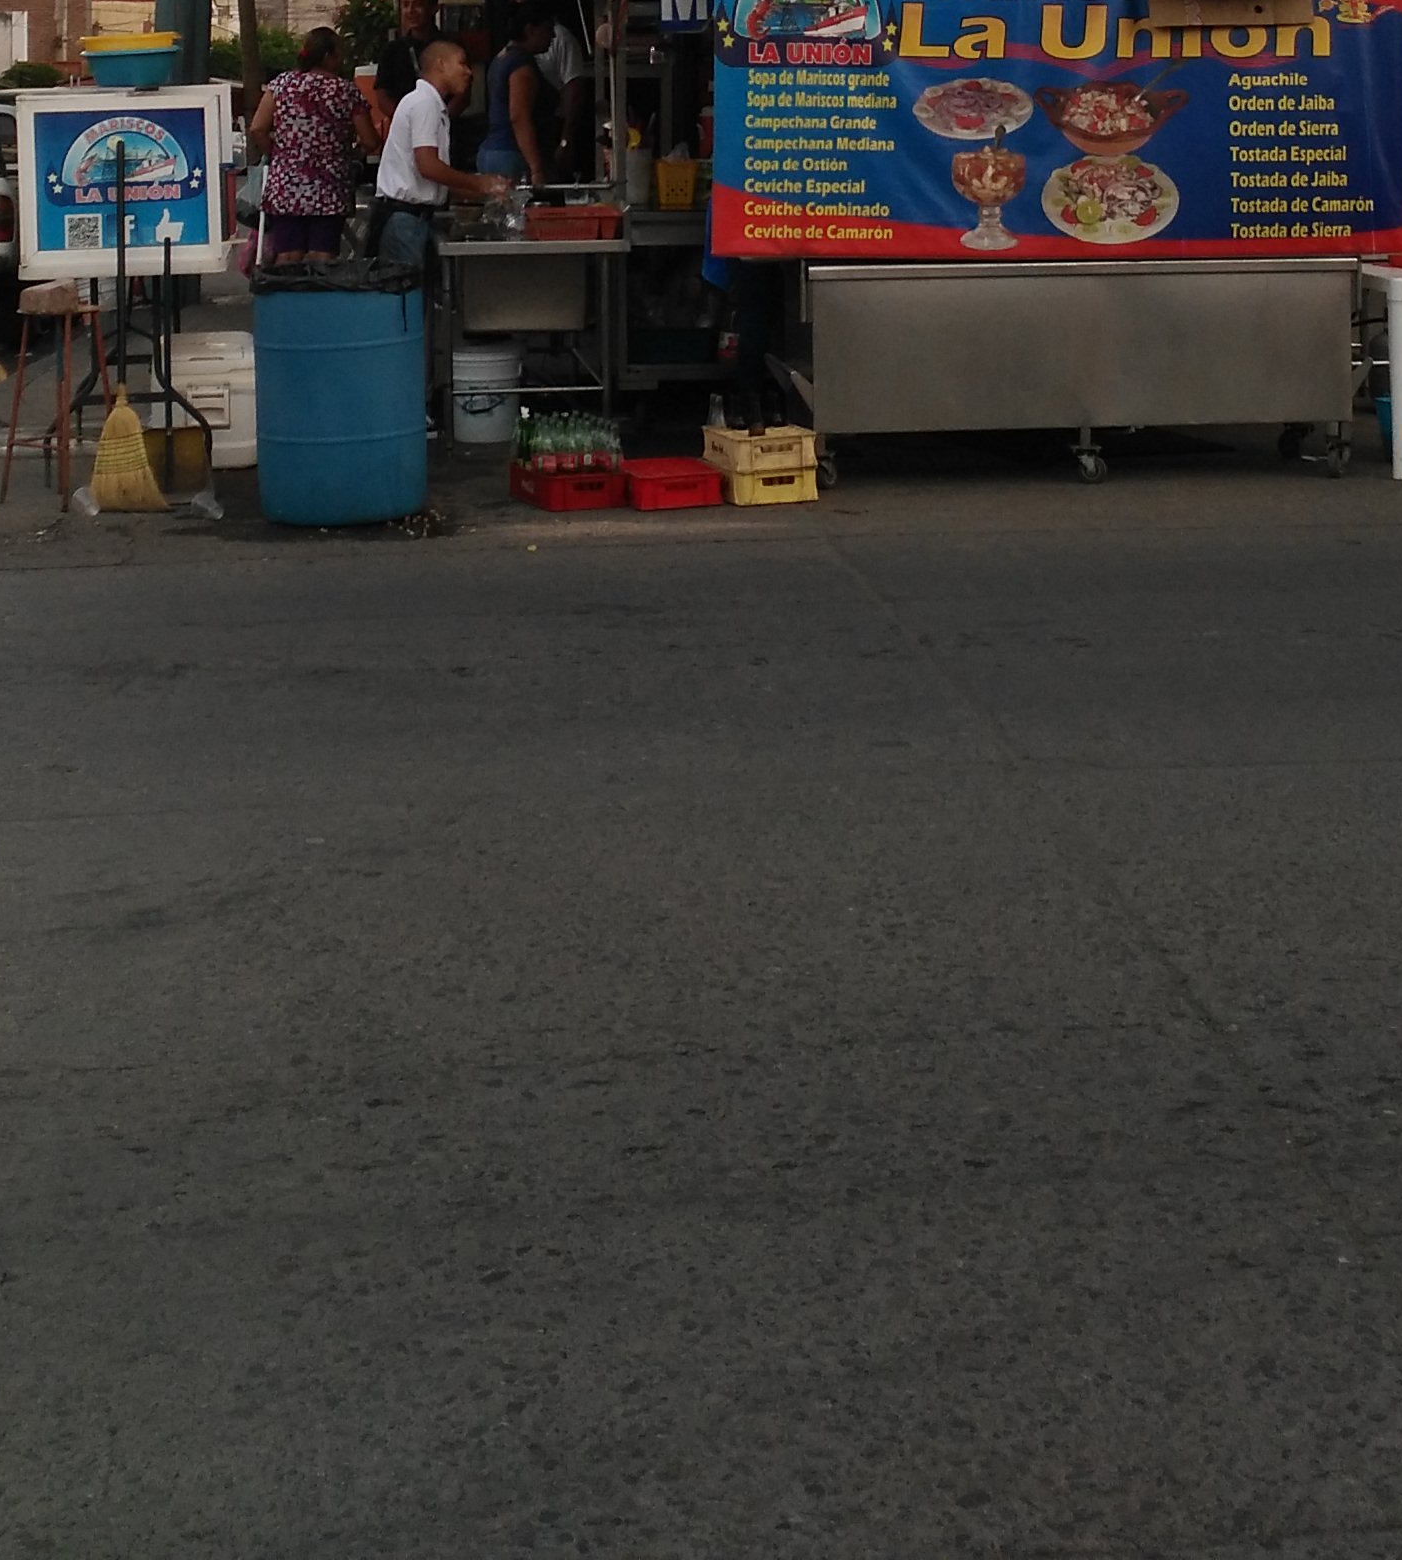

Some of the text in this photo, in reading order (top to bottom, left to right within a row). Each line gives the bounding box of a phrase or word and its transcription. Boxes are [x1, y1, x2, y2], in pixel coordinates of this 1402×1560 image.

[899, 2, 1006, 58] La
[748, 37, 872, 65] LA UNIÓN
[748, 69, 890, 90] Sopa de Mariscos grande
[1228, 72, 1308, 90] Aguachile
[747, 91, 897, 110] Sopa de Mariscos mediana
[1228, 94, 1334, 111] Orden de Jaiba
[85, 119, 165, 144] MARISCOS
[745, 114, 876, 131] Campechana Grande
[1229, 120, 1338, 136] Orden de Sierra
[745, 136, 895, 152] Campechana Mediana
[1229, 145, 1346, 166] Tostada Especial
[744, 156, 847, 174] Copa de Ostión
[744, 178, 865, 197] Ceviche Especial
[1230, 171, 1348, 187] Tostada de Jaiba
[75, 187, 102, 203] LA
[1230, 195, 1374, 213] Tostada de Camarón
[744, 201, 890, 216] Ceviche Combinado
[744, 224, 893, 239] Ceviche de Camarón
[1230, 222, 1351, 239] Tostada de Sierra
